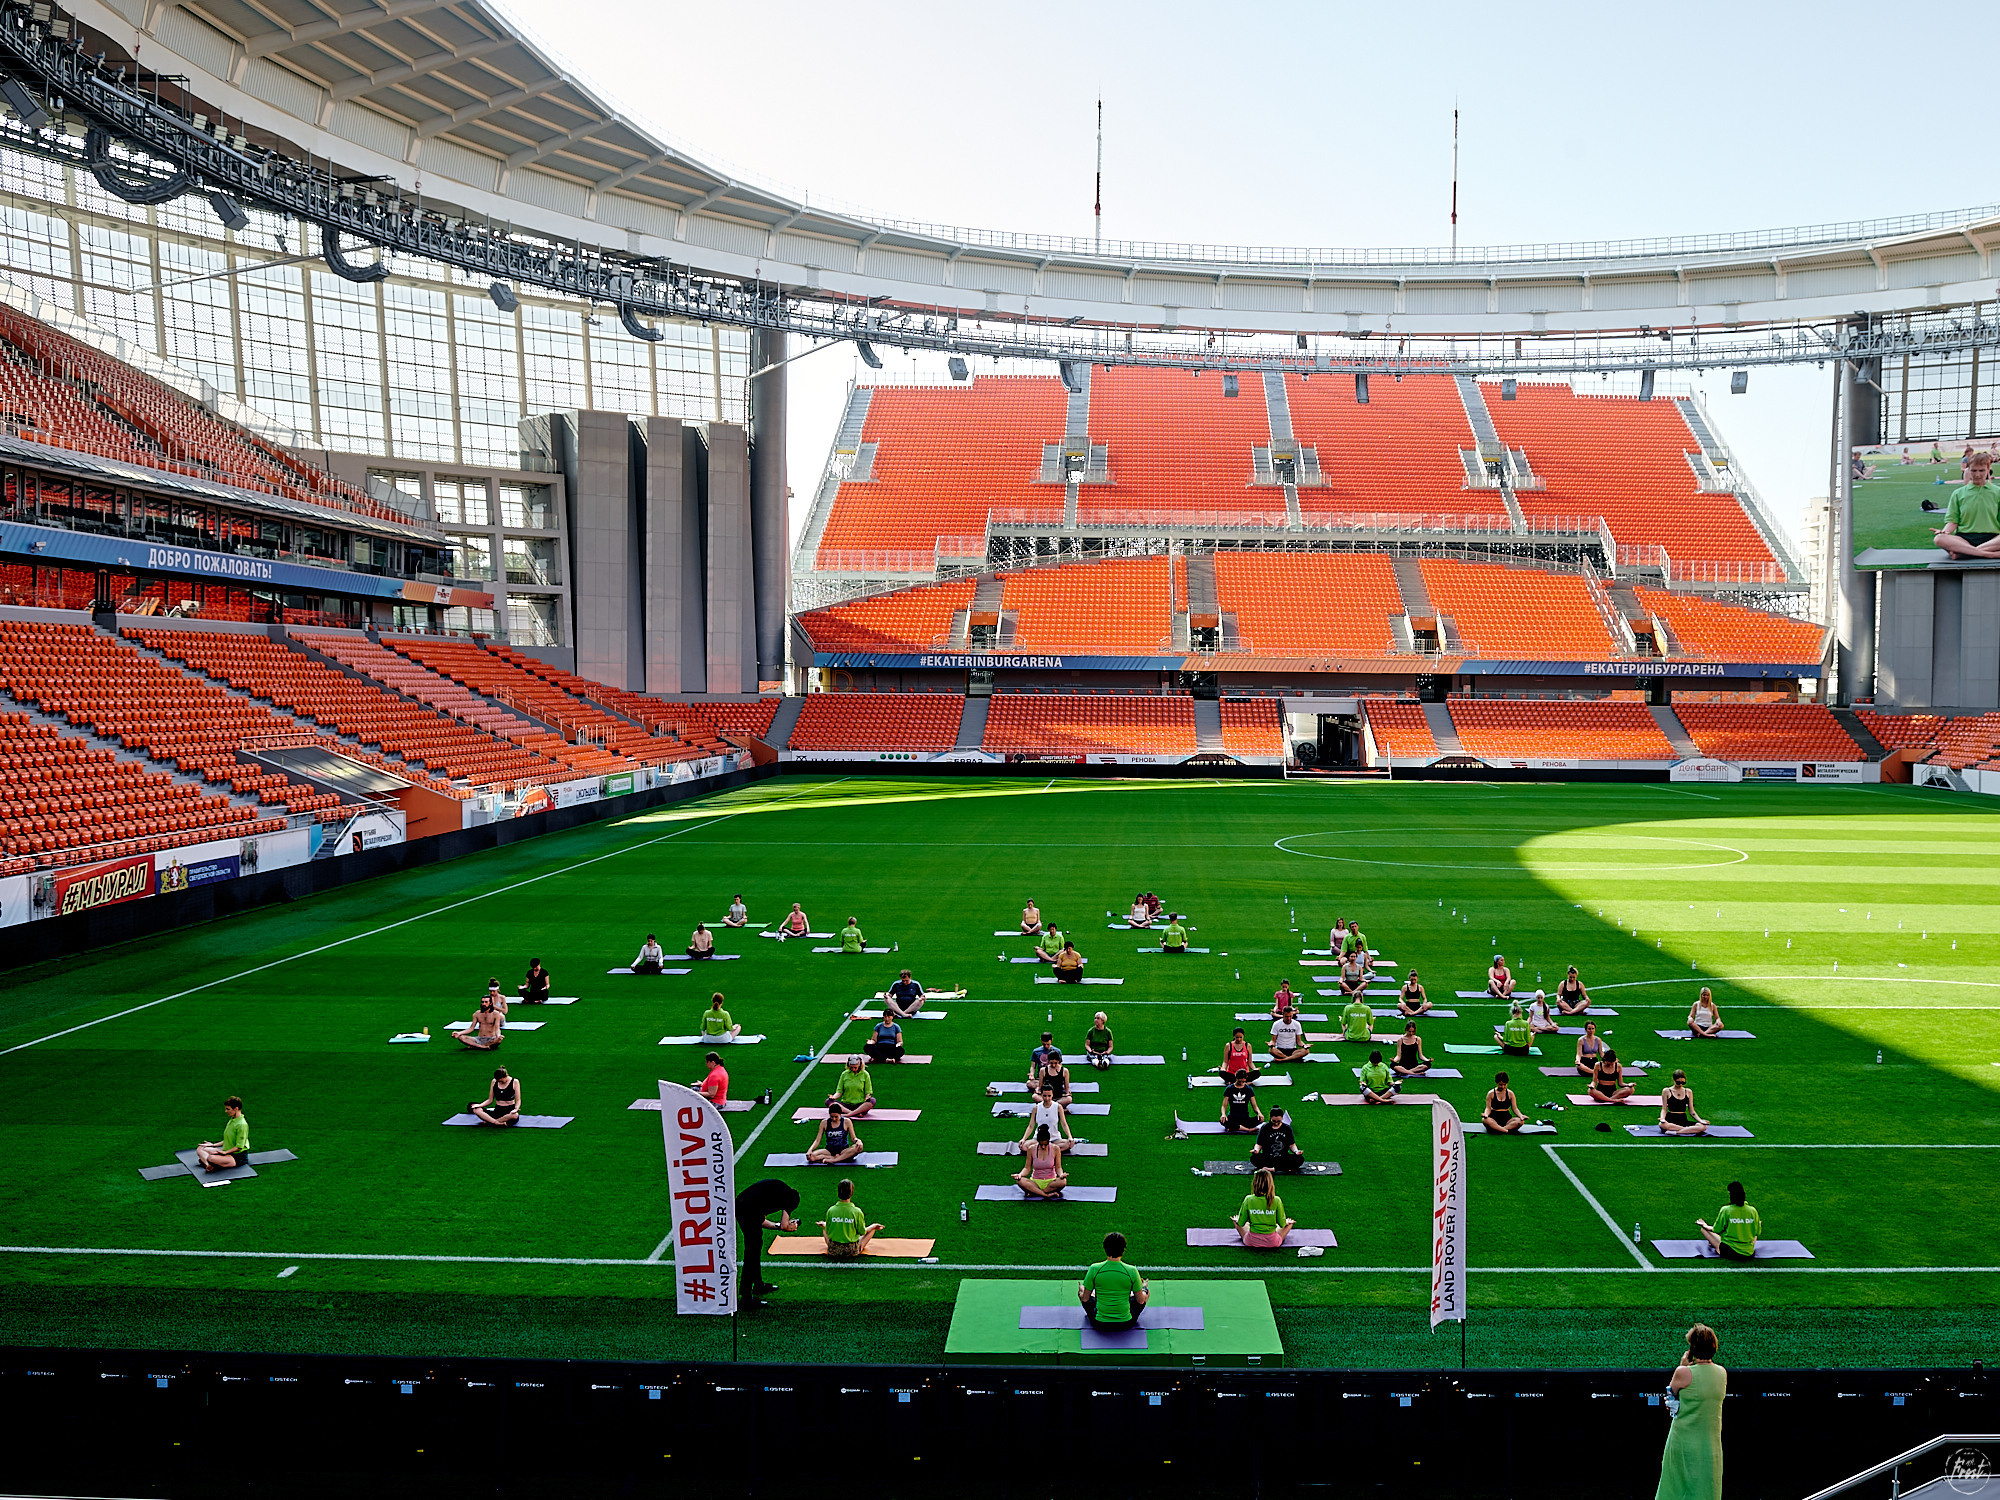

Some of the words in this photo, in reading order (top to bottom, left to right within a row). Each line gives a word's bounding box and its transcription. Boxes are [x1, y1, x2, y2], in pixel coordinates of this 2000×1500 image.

[147, 547, 191, 569] ДОБРО
[194, 554, 272, 579] ПОЖАЛОВАТЬ!
[920, 655, 1063, 668] #EKATERINBURGARENA
[1584, 663, 1725, 676] #ЕКАТЕРИНБУРГАРЕНА
[62, 862, 149, 916] #МЫУРАЛ
[710, 1131, 726, 1193] JAGUAR
[1449, 1140, 1460, 1201] JAGUAR
[673, 1106, 716, 1303] #LRdrive
[716, 1206, 727, 1260] ROVER
[1445, 1217, 1455, 1266] ROVER
[718, 1263, 729, 1307] LAND
[1444, 1271, 1455, 1312] LAND
